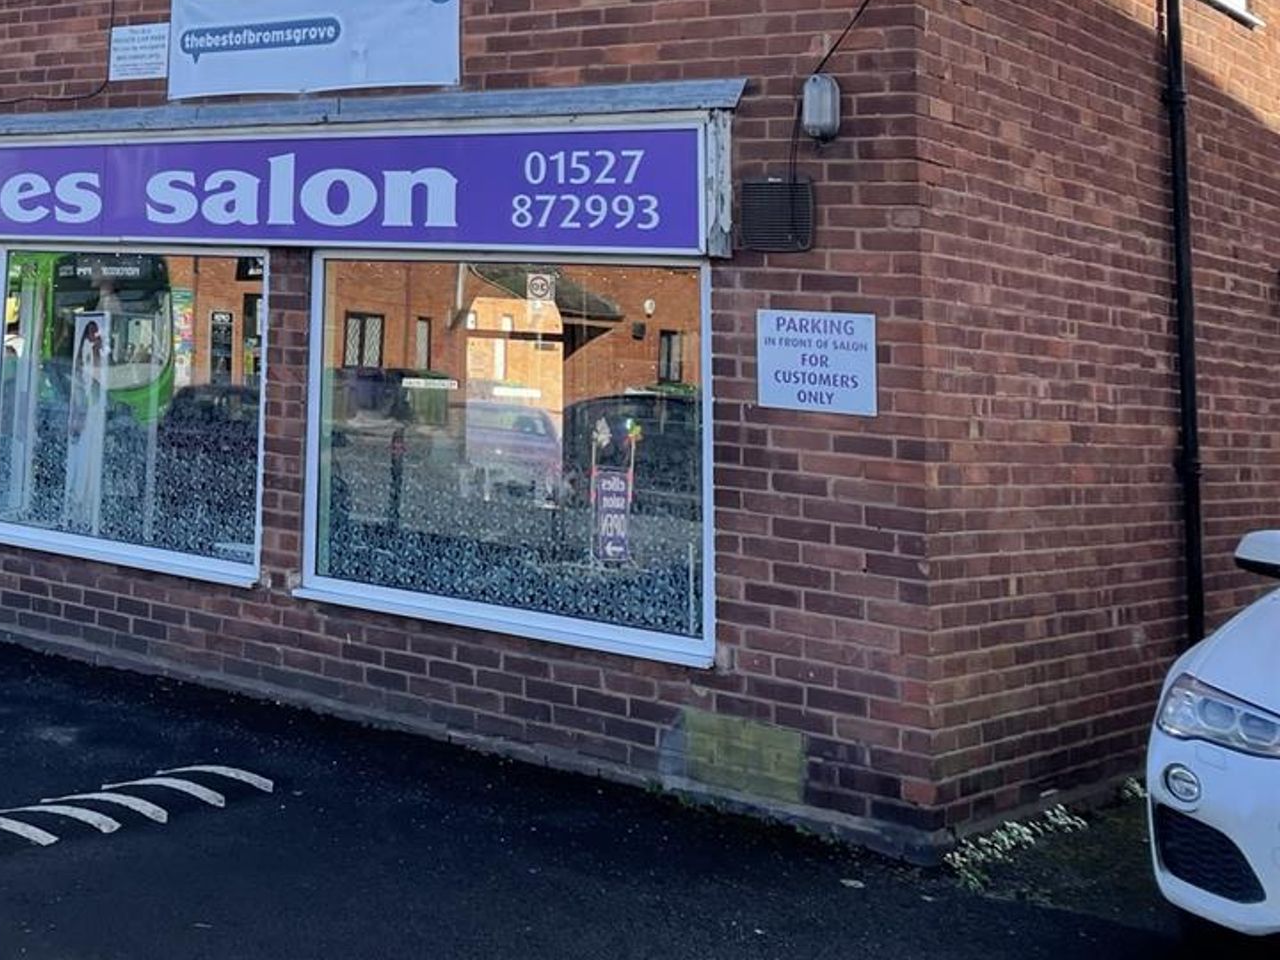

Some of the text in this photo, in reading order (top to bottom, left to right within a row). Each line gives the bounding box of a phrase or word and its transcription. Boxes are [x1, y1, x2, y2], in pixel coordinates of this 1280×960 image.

[183, 22, 336, 50] thebestofbromsgrove
[523, 149, 645, 185] 01527
[144, 152, 457, 228] salon
[510, 194, 660, 230] 872993
[775, 315, 855, 336] PARKING
[764, 337, 868, 352] IN FRONT OF SALON
[801, 353, 829, 368] FOR
[774, 370, 859, 389] CUSTOMERS
[797, 389, 835, 405] ONLY
